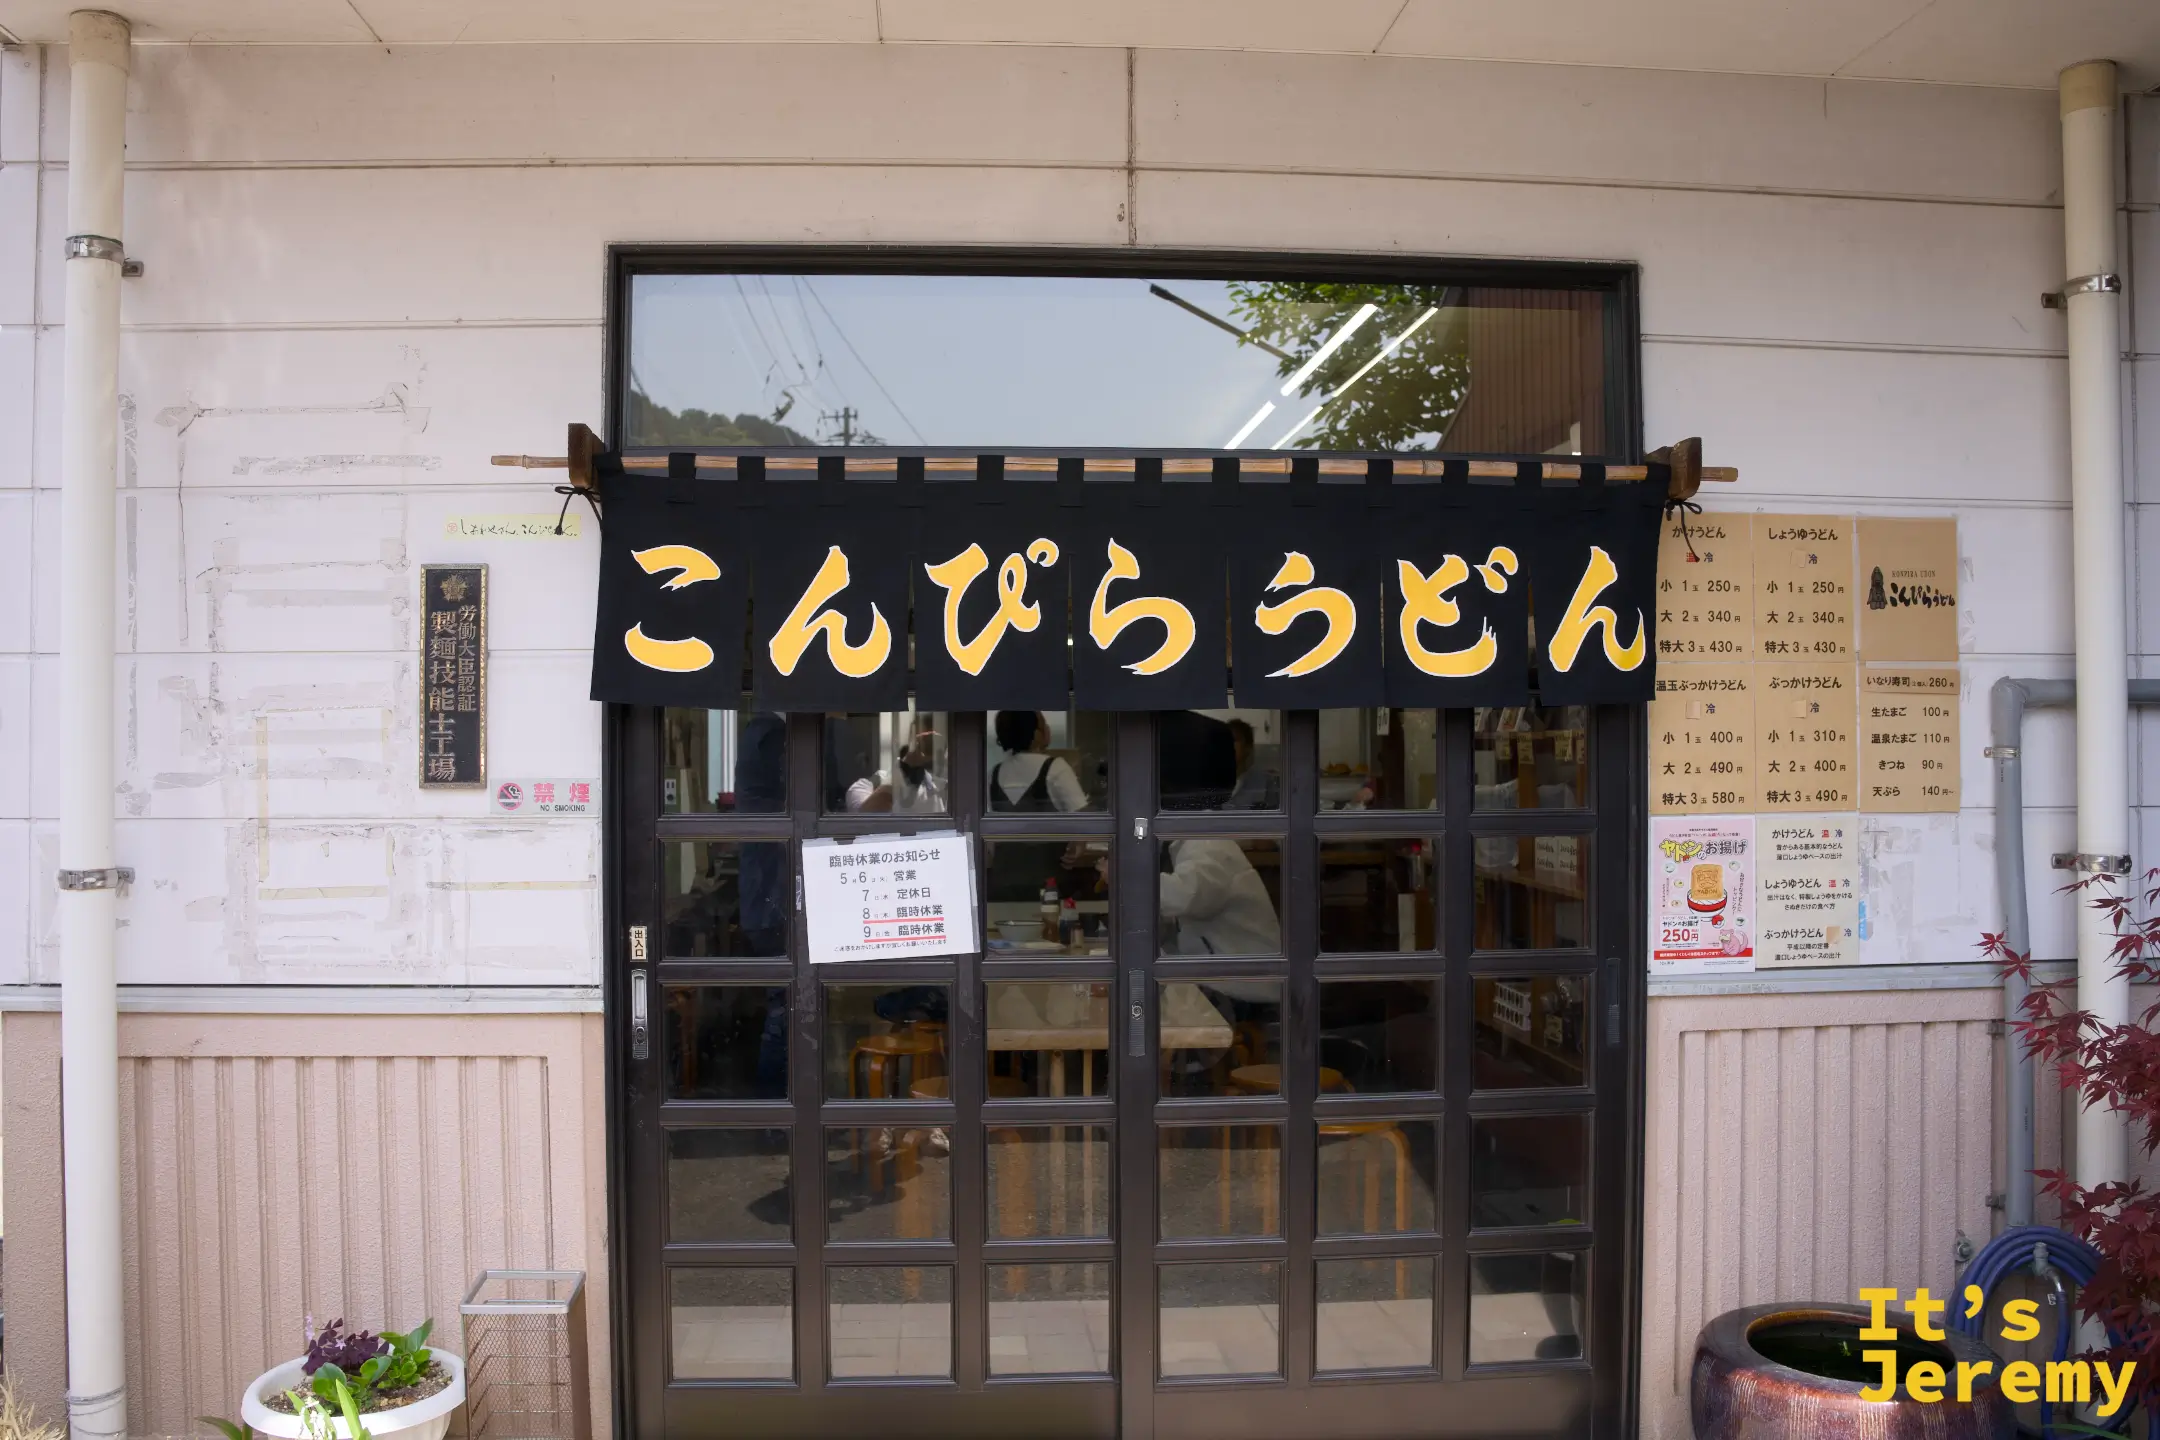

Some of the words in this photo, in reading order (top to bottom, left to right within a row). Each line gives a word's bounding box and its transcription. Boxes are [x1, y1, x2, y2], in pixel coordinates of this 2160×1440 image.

[1672, 526, 1726, 539] かけうどん
[1768, 528, 1838, 541] しょうゆうどん
[1704, 552, 1713, 563] 冷
[1808, 553, 1818, 564] 冷
[1660, 580, 1673, 592] 小
[1766, 580, 1778, 593] 小
[624, 537, 1646, 678] こんぴらうどん
[1660, 610, 1672, 622] 大
[1767, 611, 1778, 624] 大
[1660, 640, 1684, 652] 特大
[1765, 641, 1789, 654] 特大
[458, 605, 478, 713] 労働大臣認証
[1656, 679, 1746, 692] 温玉ぶっかけうどん
[1769, 676, 1842, 689] ぶっかけうどん
[1867, 676, 1910, 686] いなり寿司
[1706, 703, 1716, 714] 冷
[1810, 702, 1820, 714] 冷
[1872, 707, 1906, 718] 生たまご
[1662, 732, 1674, 744] 小
[1768, 730, 1780, 742] 小
[1871, 734, 1916, 744] 温泉たまご
[1663, 762, 1676, 774] 大
[1768, 761, 1780, 773] 大
[1878, 760, 1905, 770] きつね
[1662, 792, 1686, 805] 特大
[1767, 790, 1791, 803] 特大
[1772, 829, 1814, 838] かけうどん
[1822, 830, 1830, 838] 温
[1835, 829, 1842, 838] 冷
[1659, 838, 1748, 863] ヤドンのお揚げ
[830, 848, 940, 868] 臨時休業のお知らせ
[894, 870, 916, 882] 営業
[1765, 879, 1822, 888] しょうゆうどん
[1828, 880, 1836, 888] 温
[1842, 878, 1850, 888] 冷
[897, 887, 931, 900] 定休日
[897, 904, 944, 918] 臨時休業
[898, 923, 944, 936] 臨時休業
[1663, 929, 1698, 942] 250円
[1764, 928, 1824, 940] ぶっかけうどん
[1844, 928, 1852, 936] 冷
[634, 930, 644, 956] 出入口
